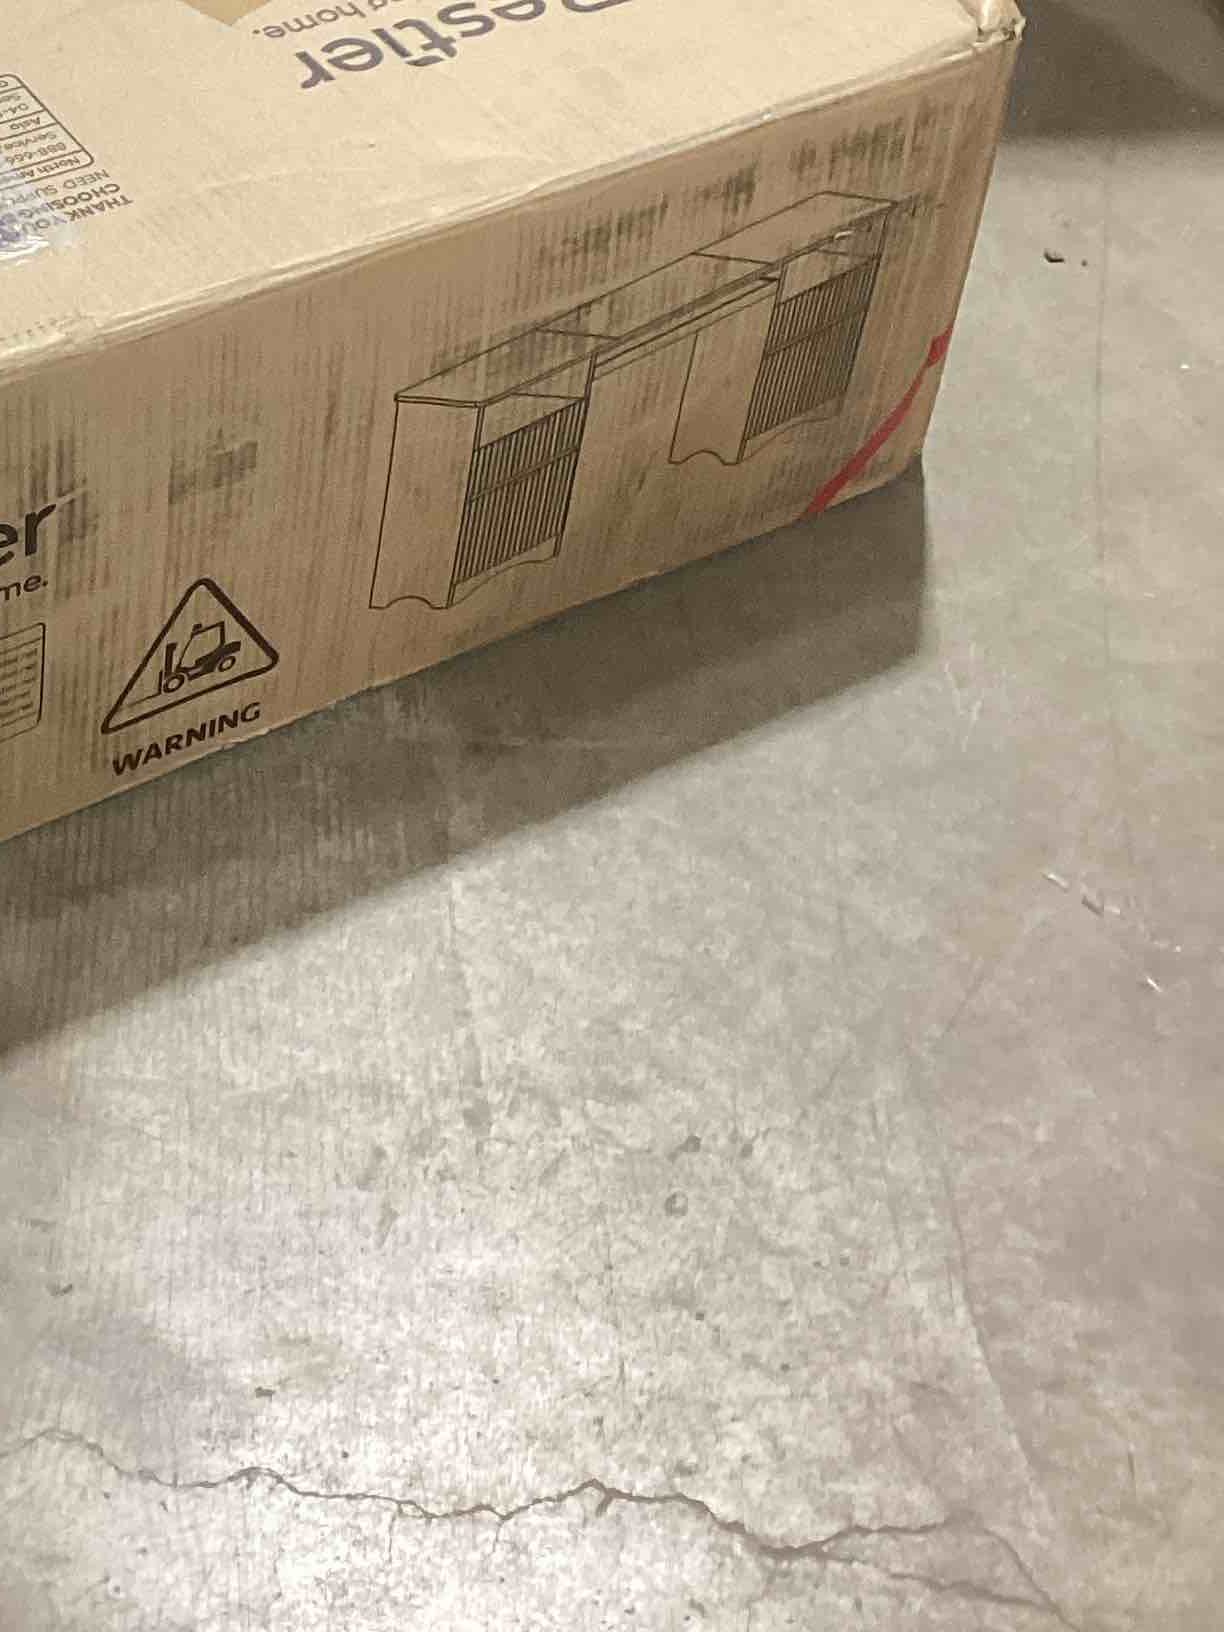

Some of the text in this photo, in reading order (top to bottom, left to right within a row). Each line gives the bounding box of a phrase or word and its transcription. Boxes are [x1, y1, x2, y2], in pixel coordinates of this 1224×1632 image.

[251, 0, 368, 41] home.
[62, 168, 111, 190] NEED
[67, 192, 135, 223] THANK
[112, 701, 261, 777] WARNING
